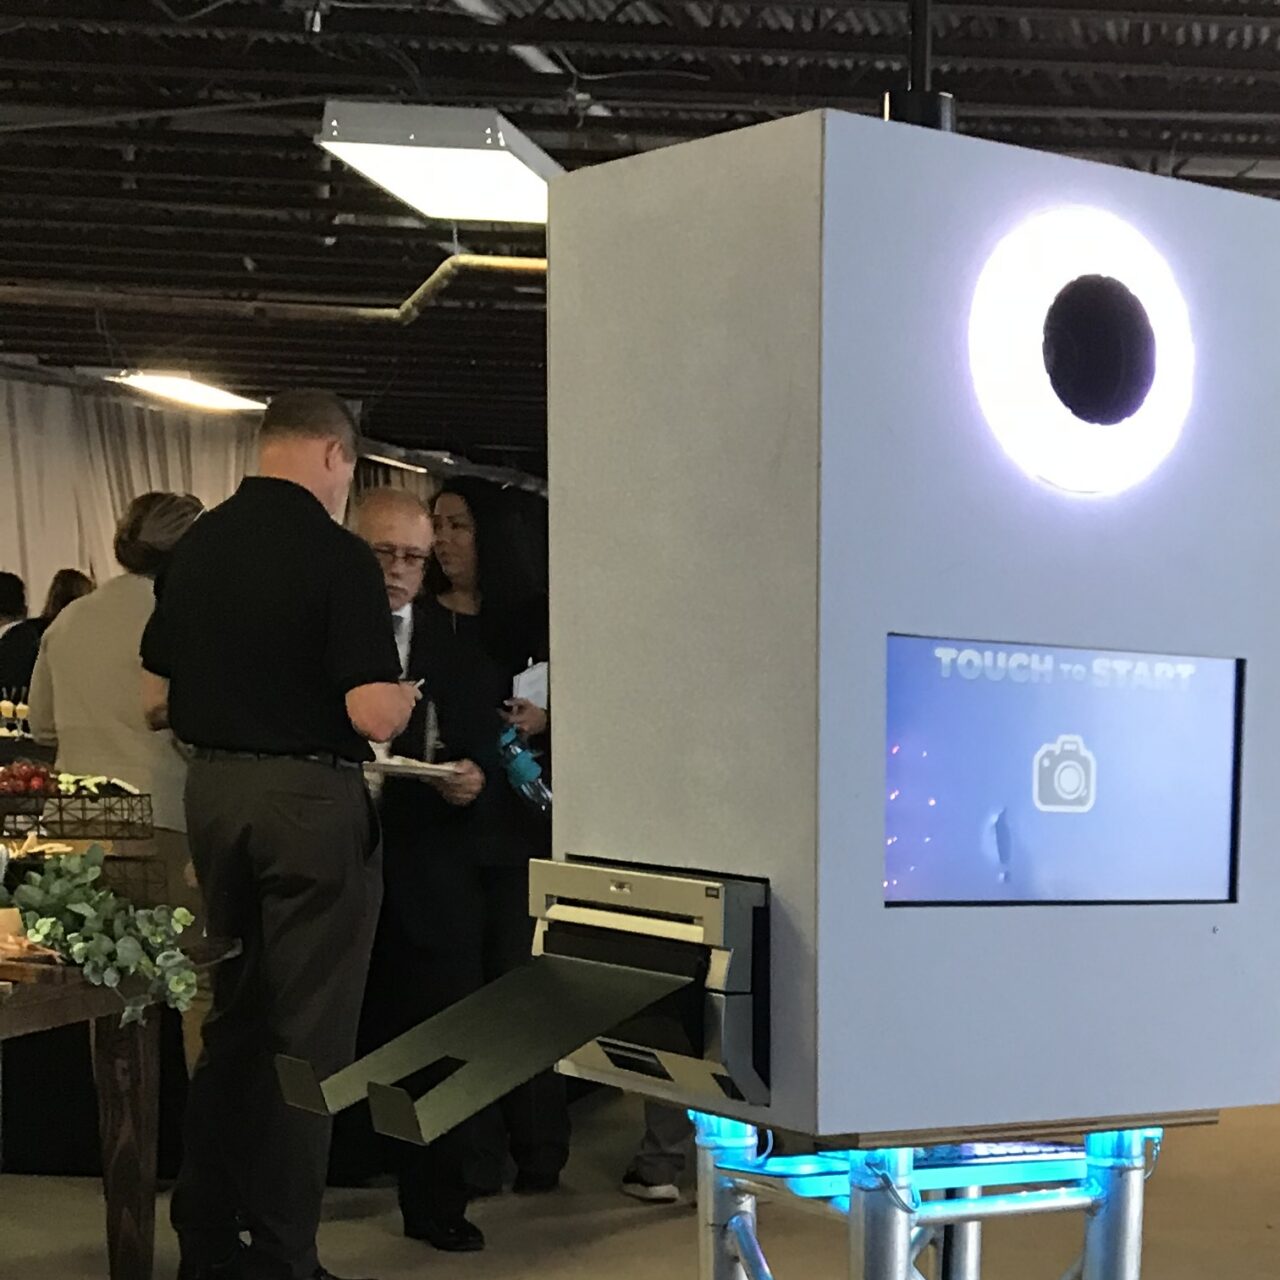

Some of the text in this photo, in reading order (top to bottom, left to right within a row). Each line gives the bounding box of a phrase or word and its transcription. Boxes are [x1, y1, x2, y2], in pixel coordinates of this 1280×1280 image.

[934, 646, 1196, 691] TOUCH TO START
